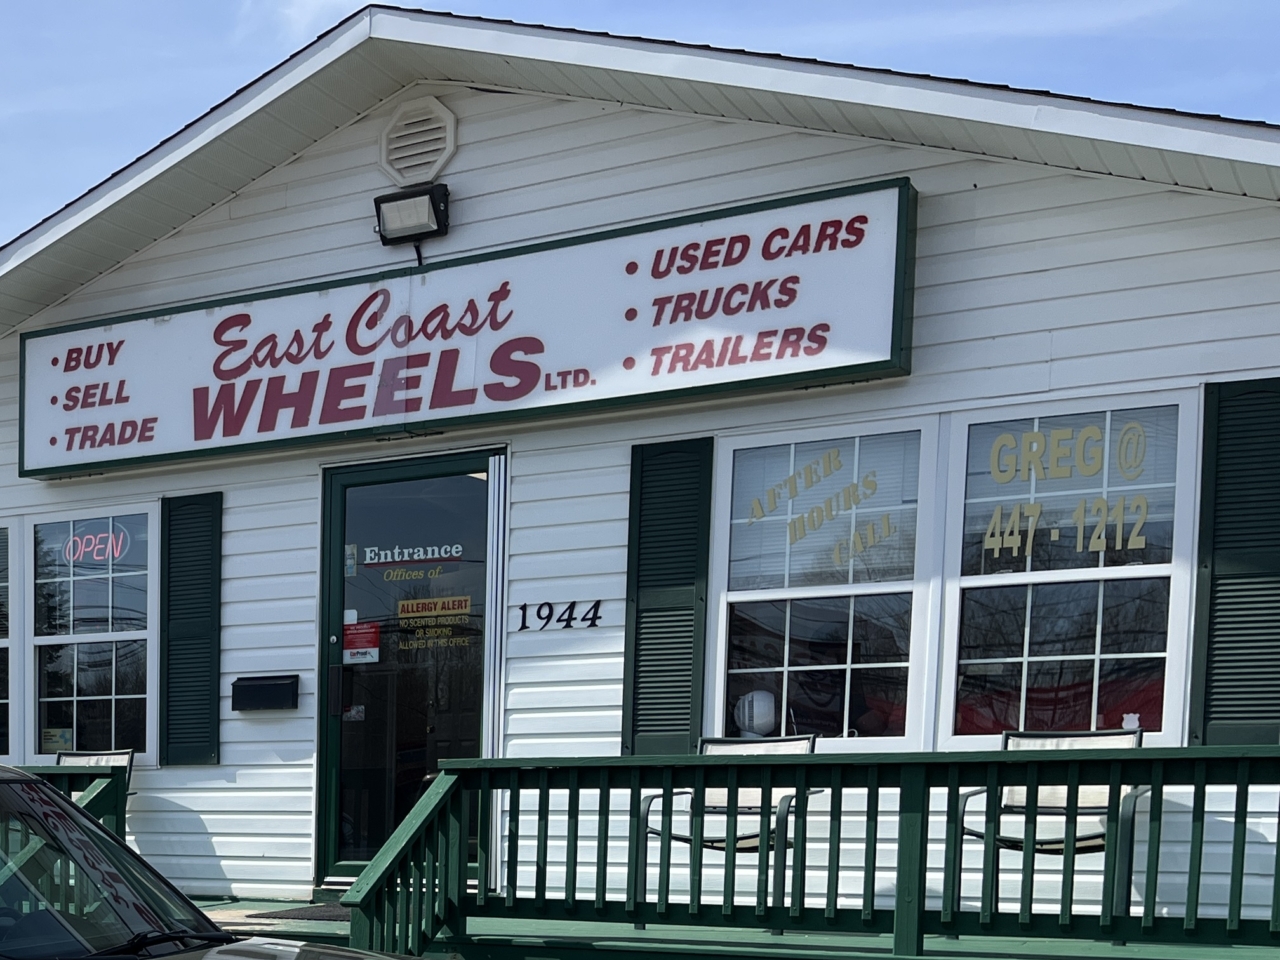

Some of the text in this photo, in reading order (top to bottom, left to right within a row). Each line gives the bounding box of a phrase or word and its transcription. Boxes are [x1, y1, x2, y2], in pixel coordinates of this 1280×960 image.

[651, 215, 869, 279] USED CARS
[652, 275, 800, 326] TRUCKS
[212, 283, 514, 381] East Coast
[63, 340, 125, 373] BUY
[650, 323, 831, 376] TRAILERS
[62, 380, 131, 412] SELL
[193, 336, 597, 442] WHEELS LTD.
[63, 417, 158, 452] TRADE
[990, 421, 1147, 484] GREG @
[747, 447, 844, 526] AFTER
[787, 470, 879, 547] HOURS
[65, 531, 124, 562] OPEN
[363, 543, 463, 564] Entrance
[831, 511, 898, 568] CALL
[383, 568, 425, 582] Offices
[399, 615, 469, 628] NO SCENTED PRODUCTS
[400, 598, 469, 615] ALLERGY ALERT
[517, 599, 603, 632] 1944
[399, 639, 426, 650] ALLOWED
[434, 638, 448, 648] THIS
[449, 637, 470, 647] OFFICE
[415, 627, 453, 638] OR SMOKING
